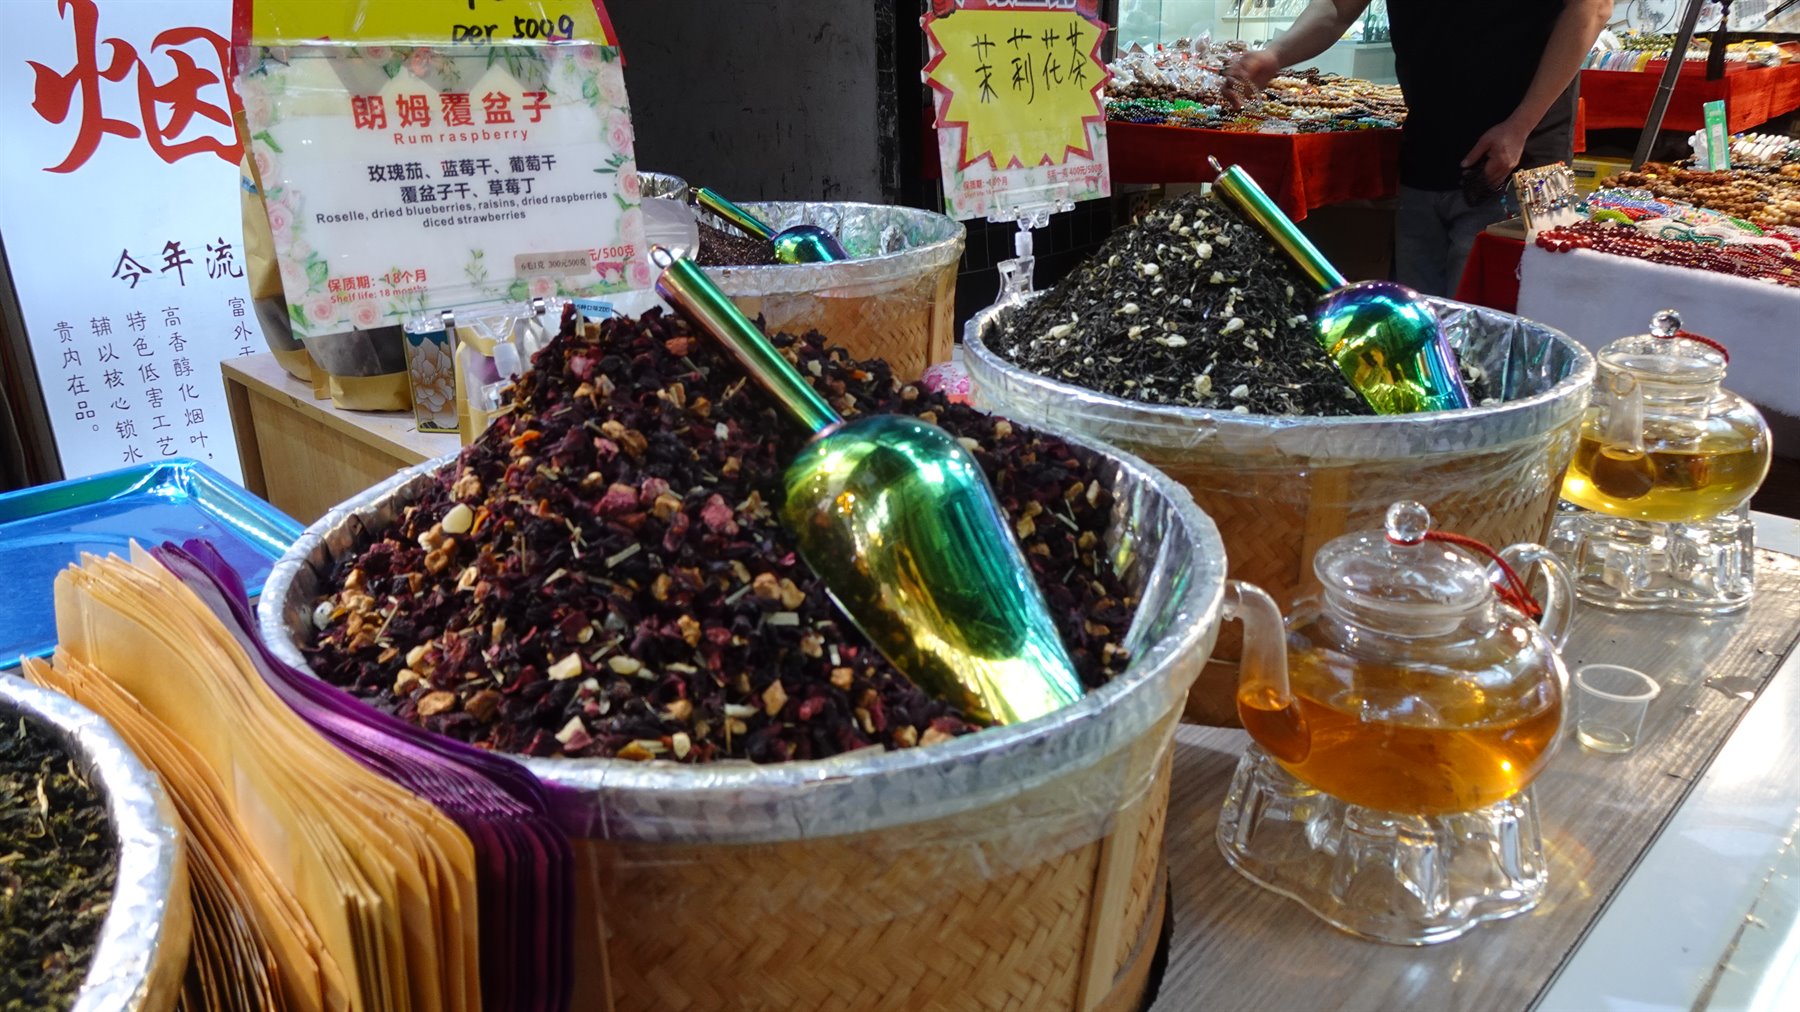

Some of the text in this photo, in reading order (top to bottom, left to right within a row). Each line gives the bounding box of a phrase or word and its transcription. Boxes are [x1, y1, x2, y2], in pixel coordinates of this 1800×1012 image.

[452, 24, 498, 46] per
[970, 20, 1089, 105] 茉莉花茶
[25, 0, 246, 174] 烟
[351, 90, 553, 131] 朗姆覆盆子
[394, 129, 529, 145] Rum raspberry
[367, 153, 557, 184] 玫瑰茄、蓝莓干、葡萄干
[316, 190, 608, 224] Roselle, dried blueberries, raisins, dried raspberries
[400, 176, 536, 205] 覆盆子干、草莓丁
[423, 210, 526, 229] diced strawberries
[111, 236, 244, 289] 今年流
[379, 289, 391, 297] 18
[90, 316, 144, 464] 辅以核心锁水
[126, 310, 179, 457] 特色低害工艺
